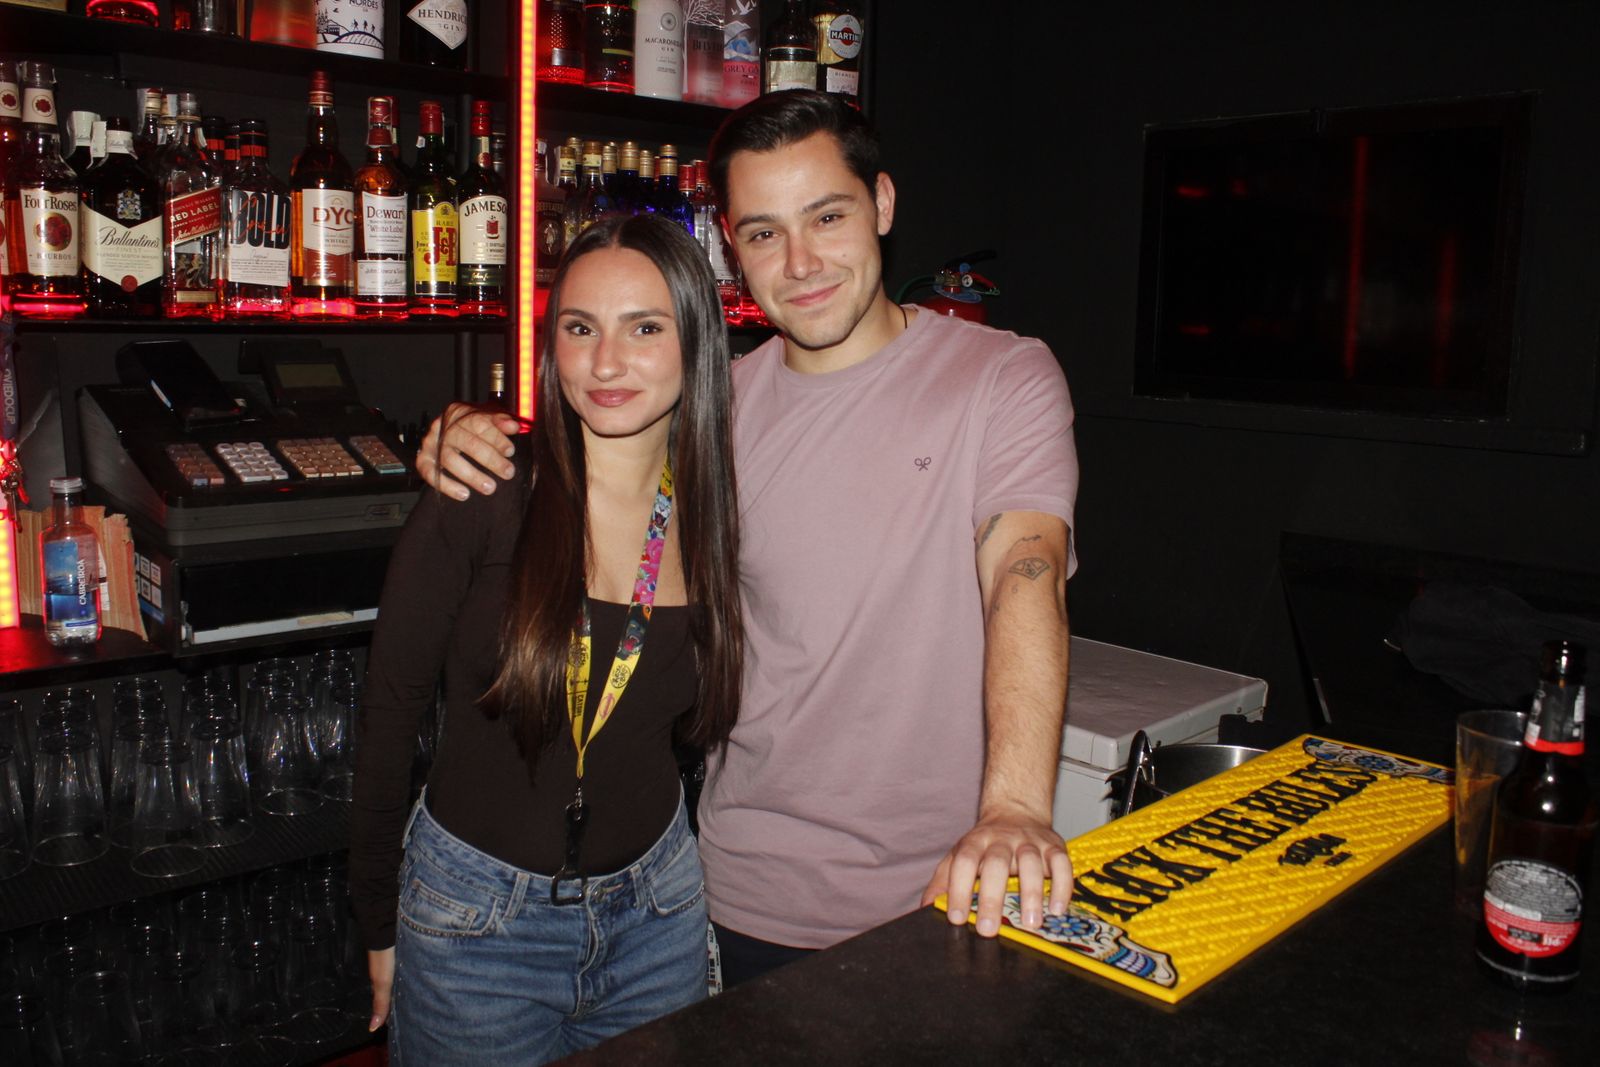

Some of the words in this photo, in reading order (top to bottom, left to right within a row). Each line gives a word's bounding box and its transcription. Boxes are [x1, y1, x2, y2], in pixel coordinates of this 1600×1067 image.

[418, 9, 468, 23] HENDRIC
[24, 195, 49, 208] Four
[50, 196, 77, 211] Roses
[170, 211, 189, 222] RED
[190, 202, 219, 216] LABEL
[230, 188, 291, 249] BOLD
[99, 225, 160, 248] Ballantine's
[1152, 806, 1292, 864] THE
[1231, 761, 1377, 825] RULES
